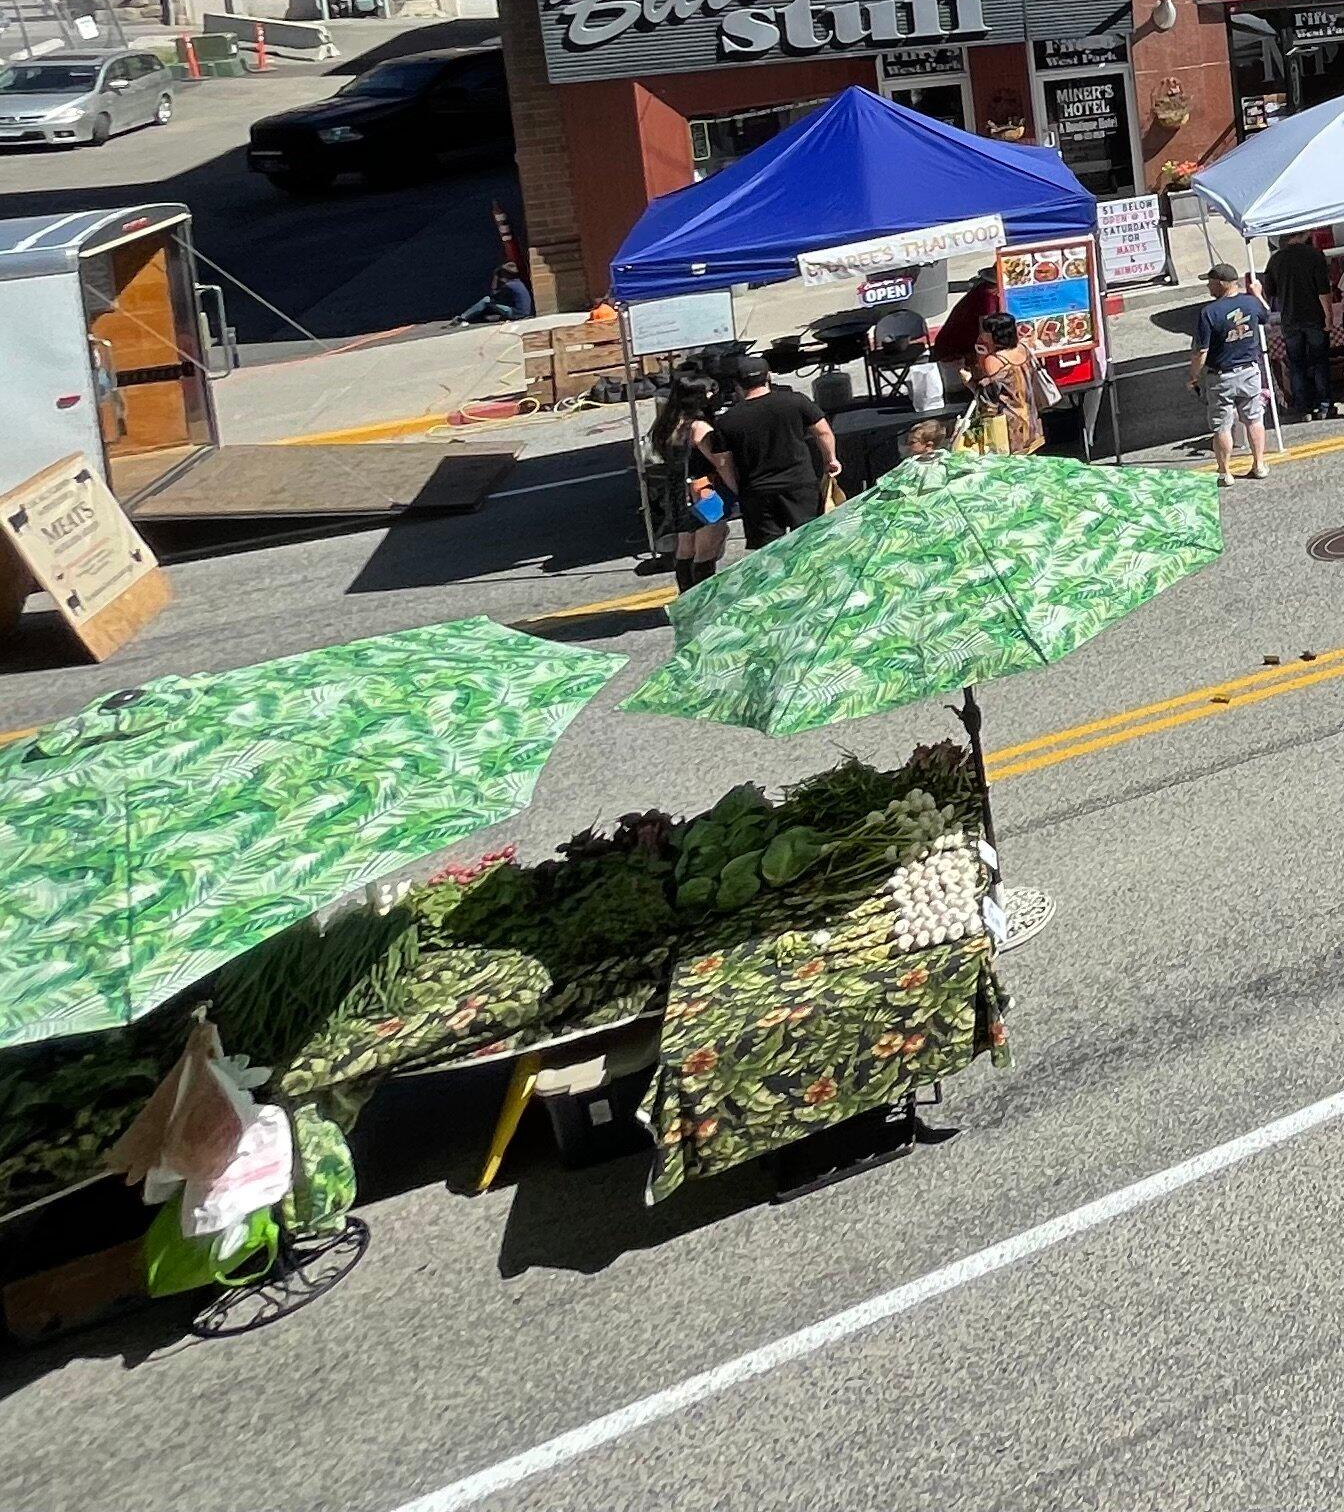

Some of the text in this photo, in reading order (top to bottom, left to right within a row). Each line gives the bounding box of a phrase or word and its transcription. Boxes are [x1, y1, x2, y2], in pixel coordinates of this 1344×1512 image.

[1294, 11, 1338, 28] Fifty
[1045, 55, 1079, 67] West
[1056, 84, 1114, 103] MINER'S
[1063, 99, 1110, 117] HOTEL
[1122, 199, 1153, 213] BELOW
[1102, 214, 1128, 225] OPEN
[1103, 219, 1157, 236] SATURDAYS
[902, 235, 947, 258] THAI
[952, 223, 1000, 247] FOOD
[1121, 233, 1140, 243] FOR
[1116, 243, 1148, 255] MARYS
[1114, 262, 1156, 276] MIMOSAS
[866, 283, 907, 303] OPEN
[40, 500, 95, 545] MEATS
